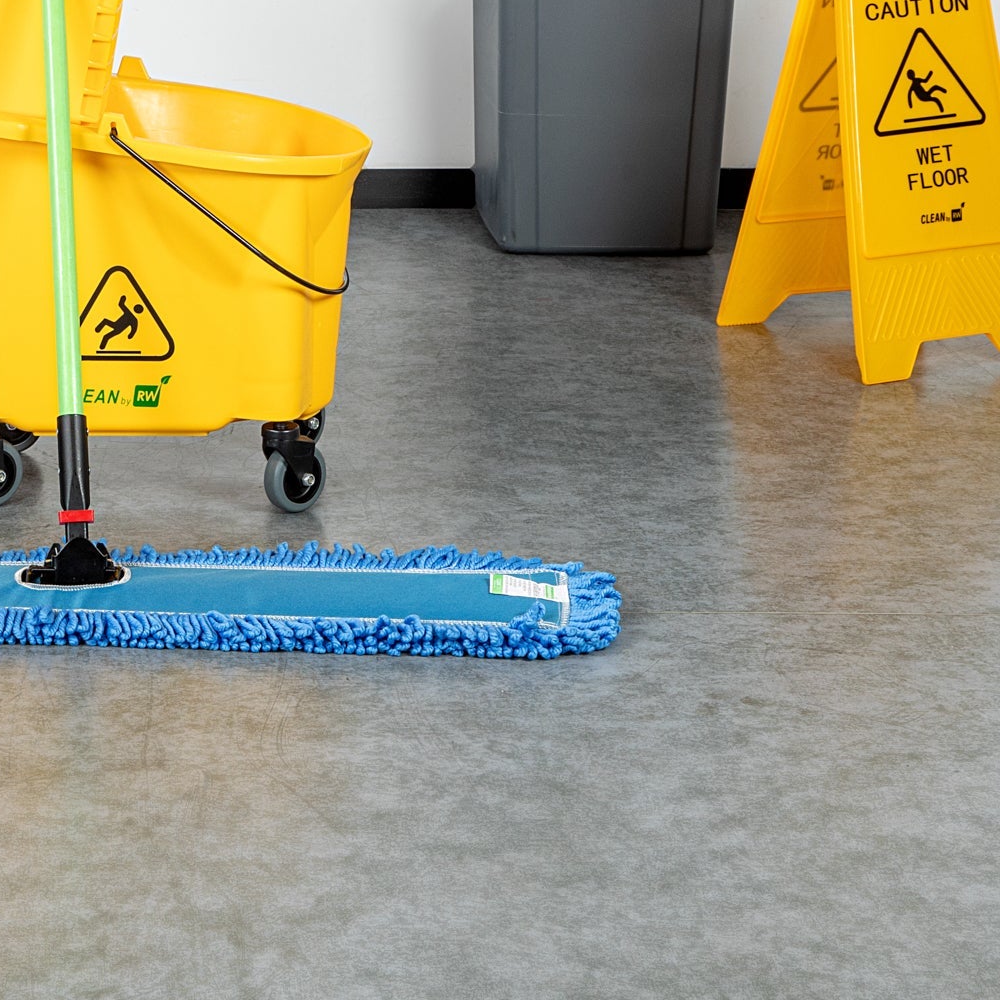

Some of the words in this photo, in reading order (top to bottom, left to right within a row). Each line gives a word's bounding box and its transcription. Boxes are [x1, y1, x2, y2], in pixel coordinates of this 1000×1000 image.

[916, 144, 953, 166] WET
[907, 167, 969, 191] FLOOR
[920, 212, 946, 225] CLEAN
[83, 388, 120, 404] EAN
[121, 397, 131, 406] by
